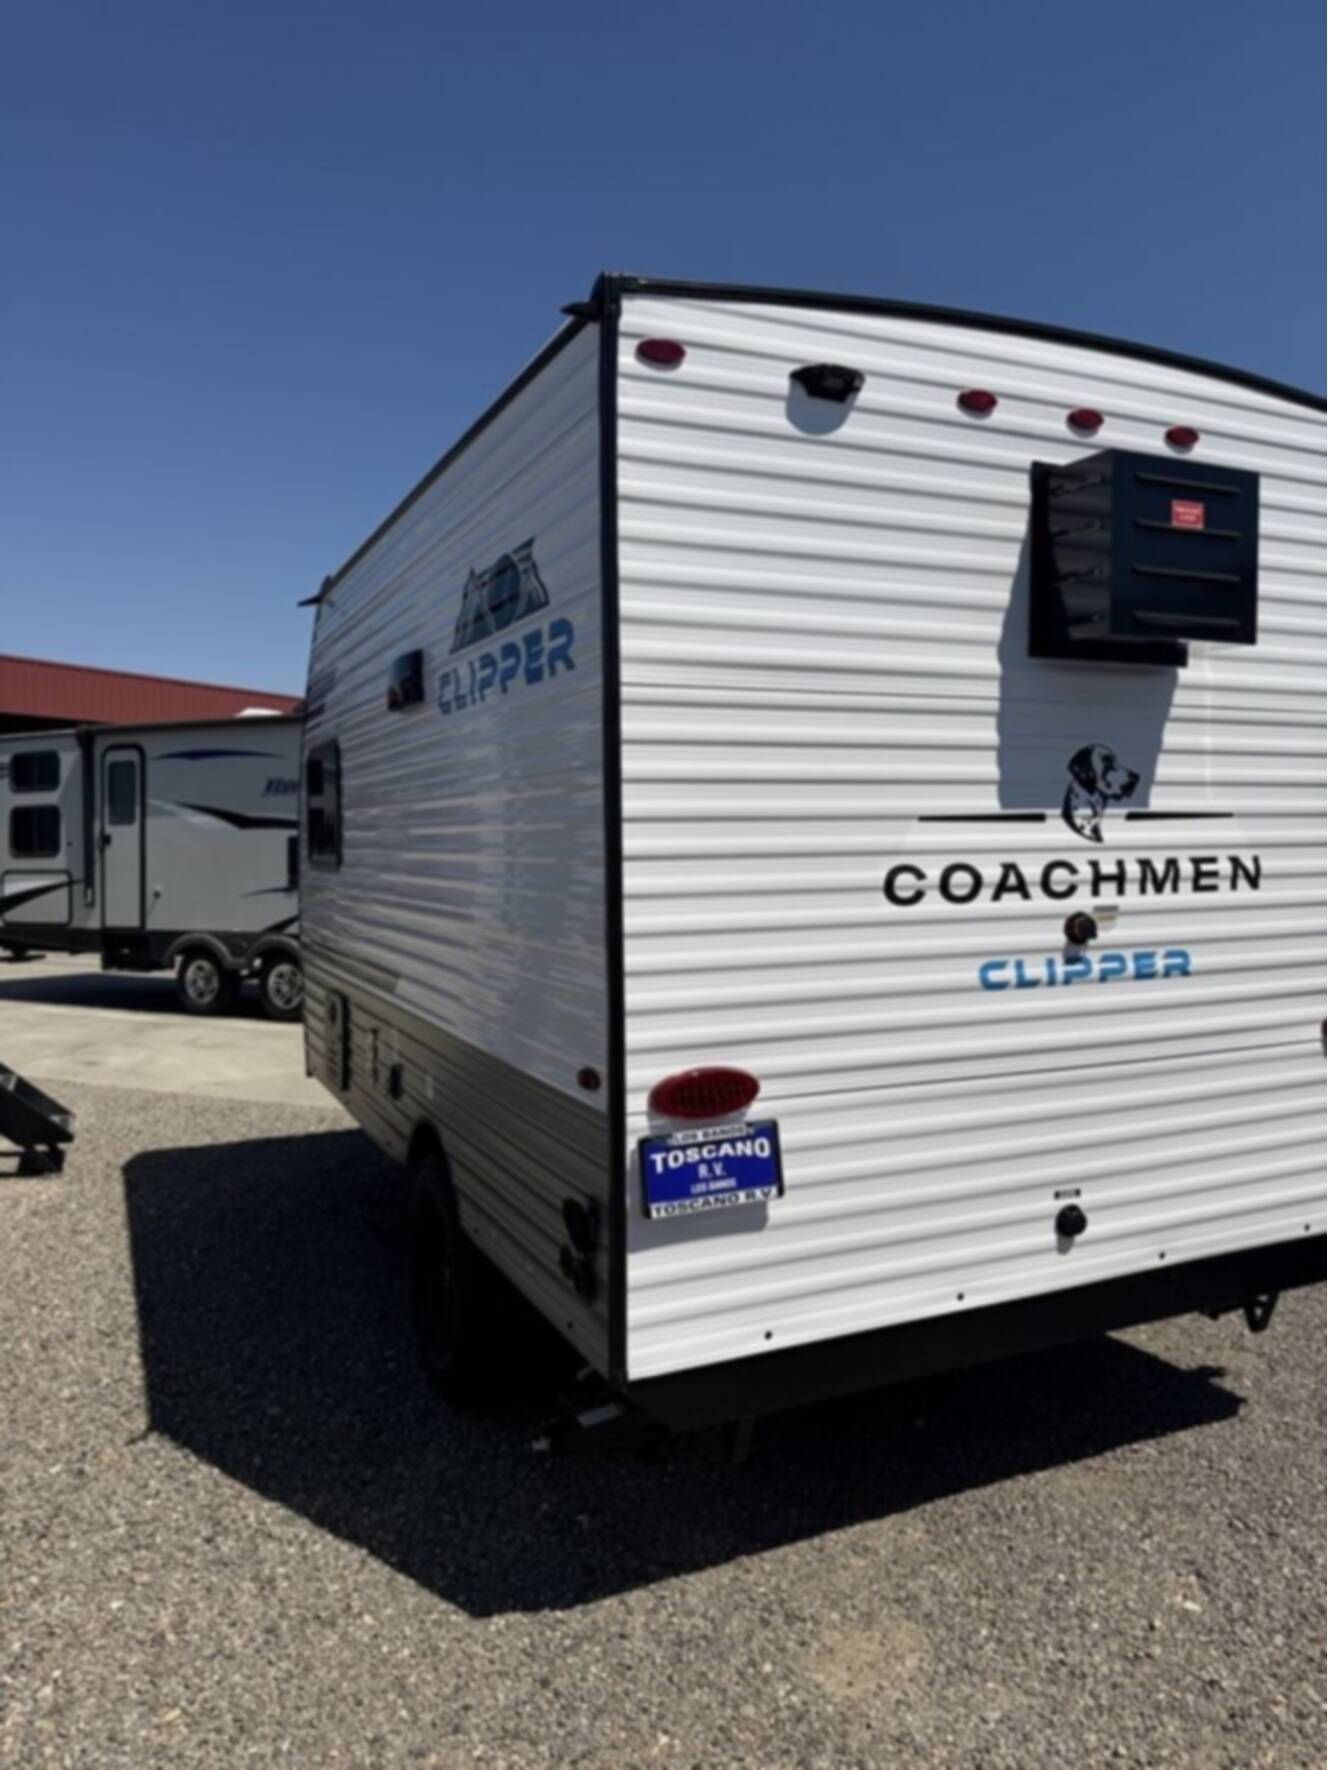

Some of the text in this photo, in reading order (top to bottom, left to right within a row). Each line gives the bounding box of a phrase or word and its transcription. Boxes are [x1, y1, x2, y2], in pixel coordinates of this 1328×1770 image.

[438, 617, 576, 716] CLIPPER
[883, 855, 1262, 907] COACHMEN
[978, 949, 1192, 991] CLIPPER
[650, 1137, 770, 1174] TOSCANO
[653, 1191, 740, 1216] TOSCANO
